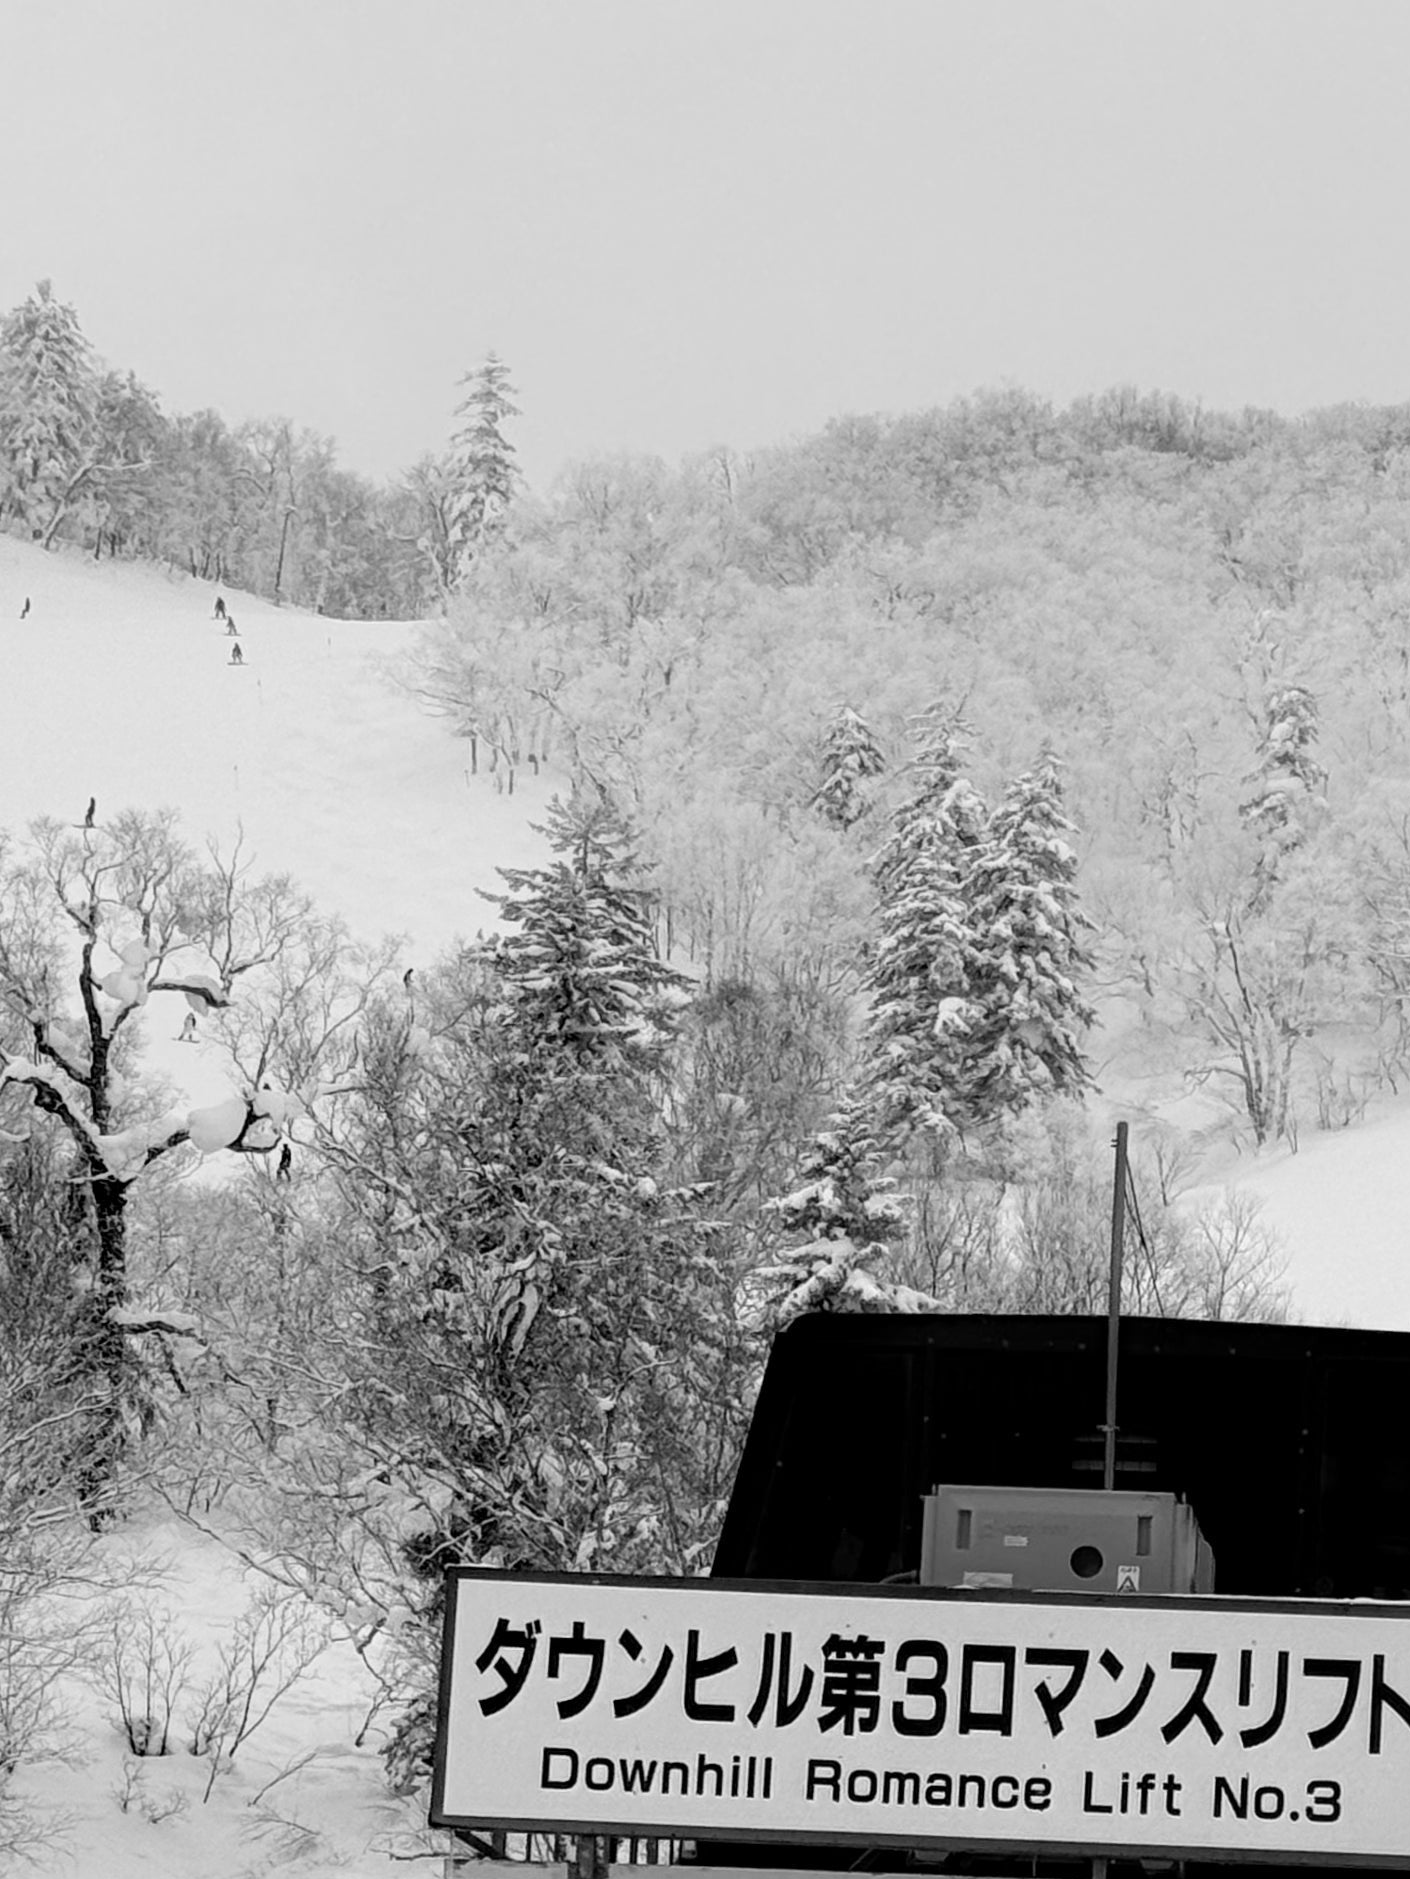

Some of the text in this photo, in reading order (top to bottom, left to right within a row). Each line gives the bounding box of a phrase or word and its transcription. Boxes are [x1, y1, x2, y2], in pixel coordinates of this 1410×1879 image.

[541, 1747, 1341, 1823] Downhill Romance Lift No.3
